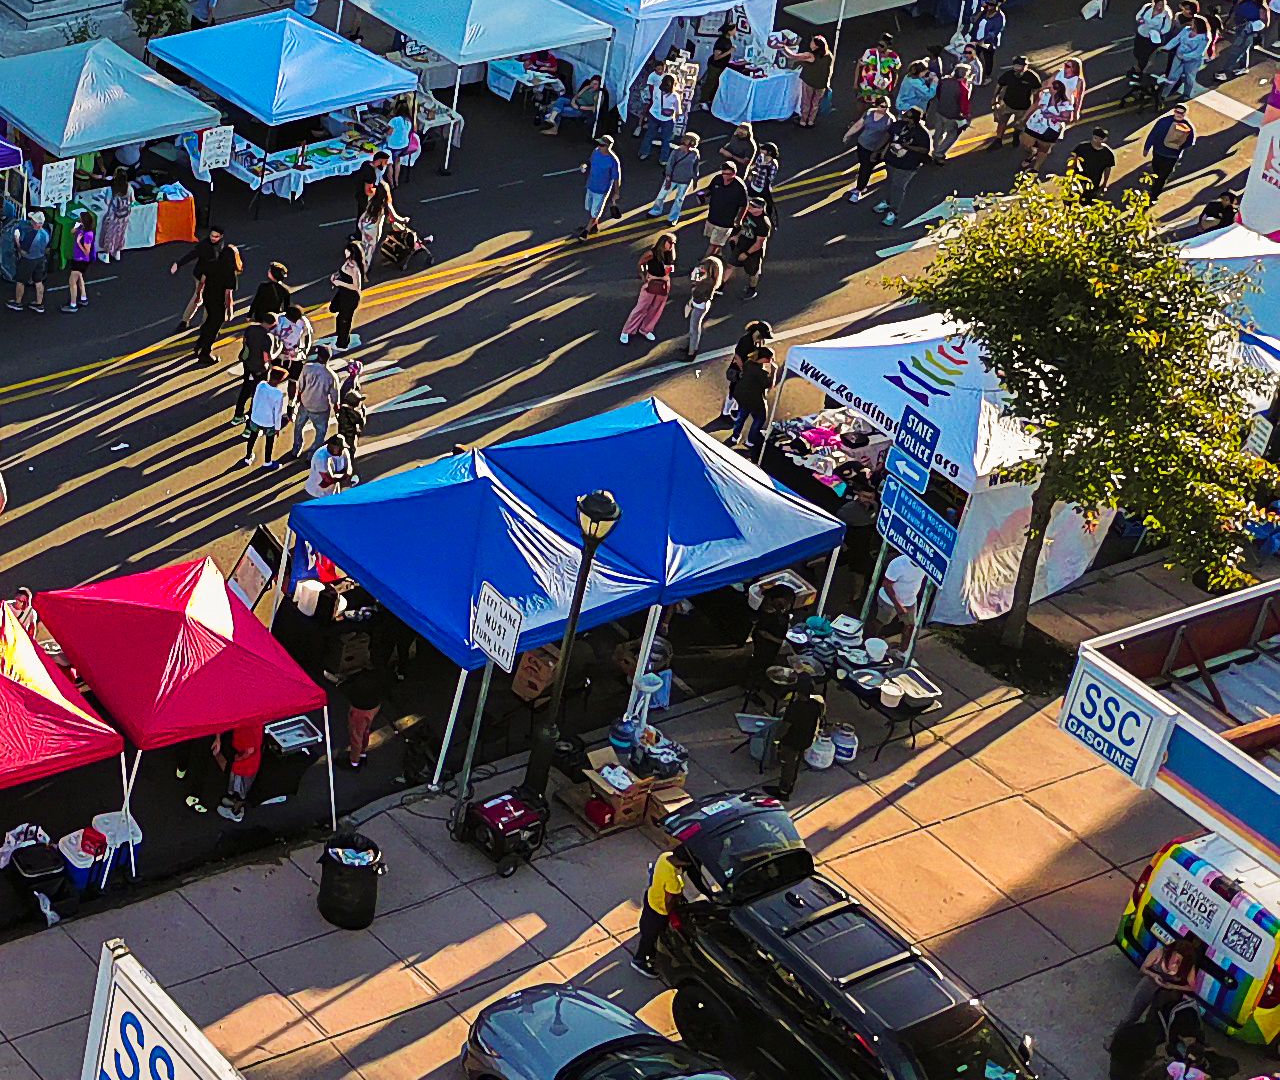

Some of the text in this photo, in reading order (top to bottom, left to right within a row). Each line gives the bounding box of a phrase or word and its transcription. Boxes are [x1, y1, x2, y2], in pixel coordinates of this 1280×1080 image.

[906, 414, 934, 443] STATE
[898, 430, 930, 465] POLICE
[900, 490, 954, 542] Reading Hospital
[901, 506, 947, 550] Trauma Center
[889, 528, 943, 581] PUBLIC MUSEUM
[905, 527, 934, 558] READING
[483, 591, 517, 629] LEFT LANE
[485, 612, 507, 641] MUST
[476, 625, 510, 662] TURN LEFT
[1080, 683, 1141, 747] SSC
[1067, 718, 1134, 773] GASOLINE
[1180, 887, 1215, 920] PRIDE
